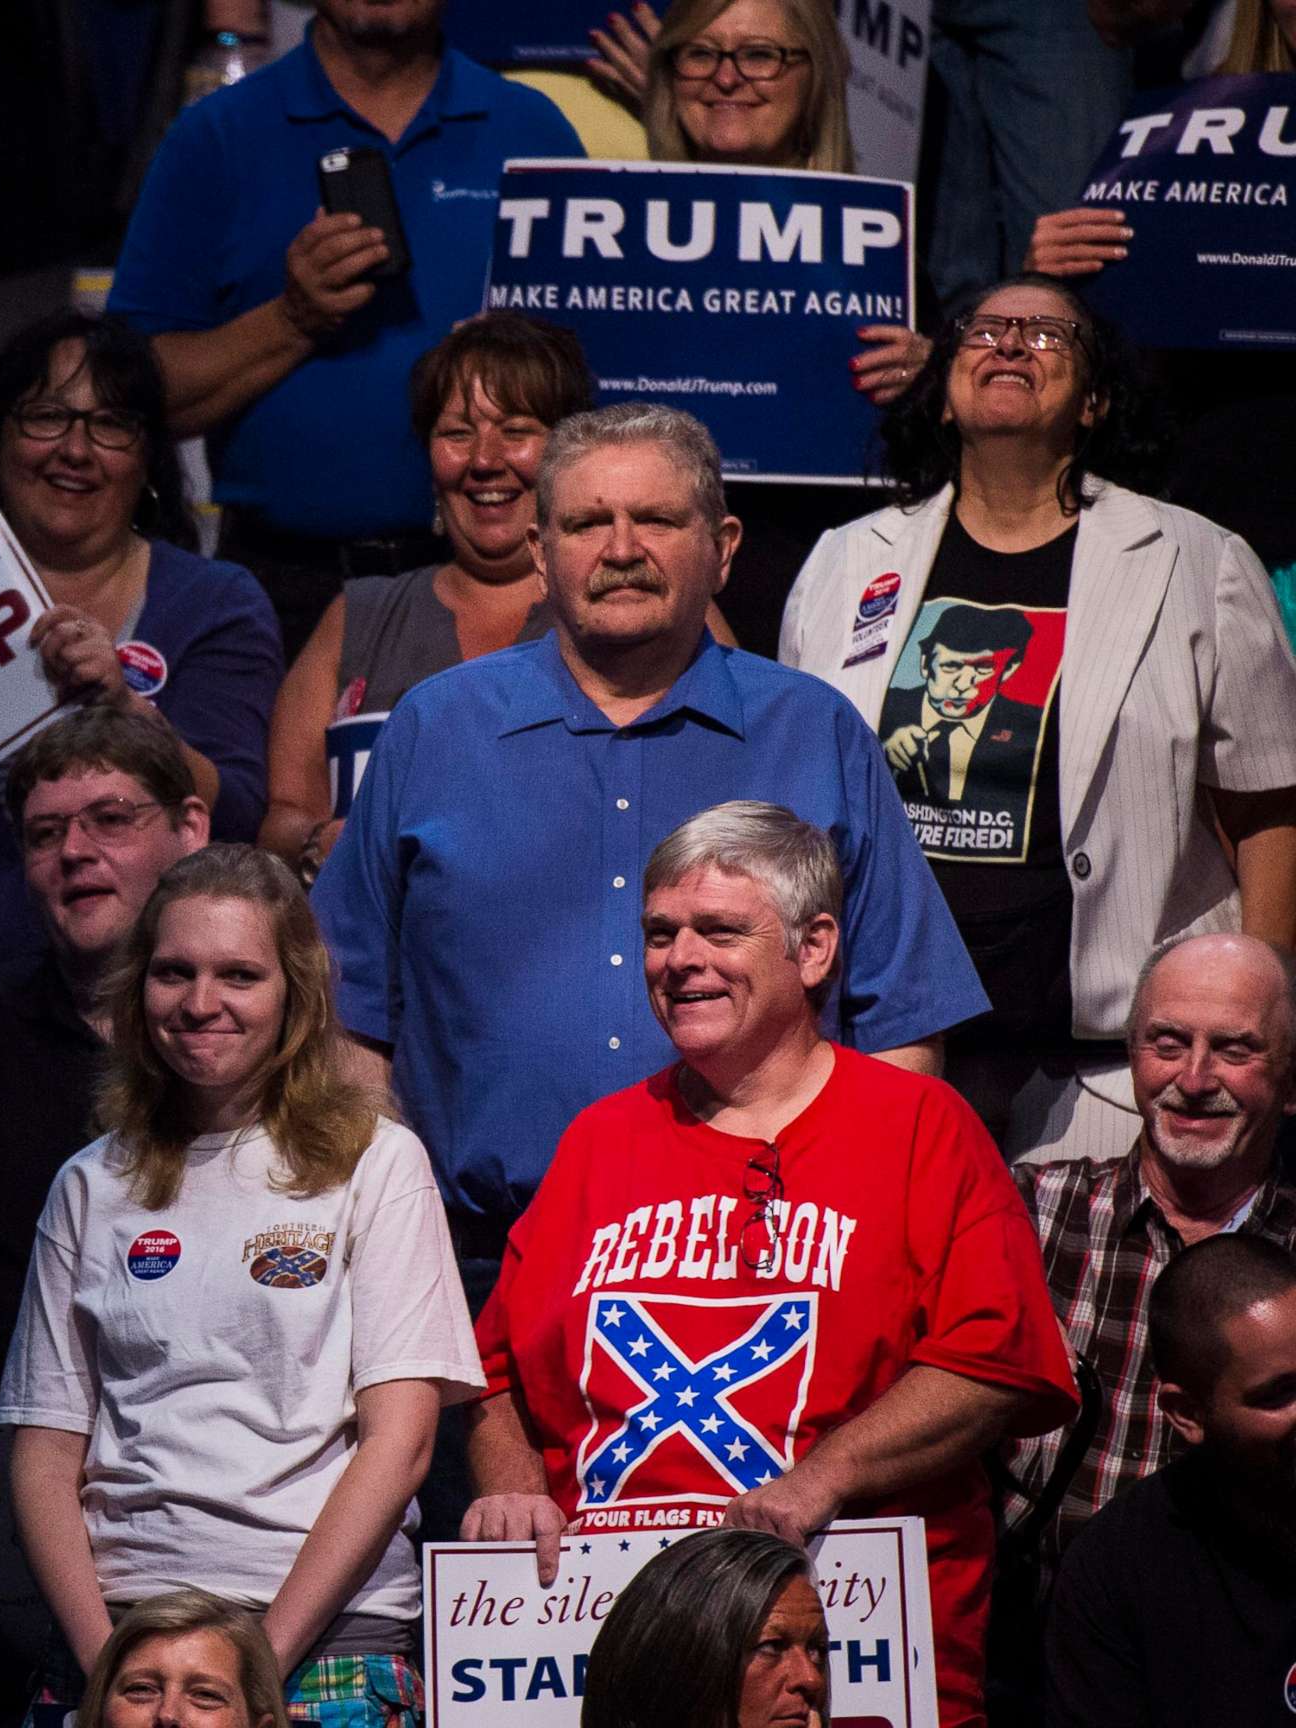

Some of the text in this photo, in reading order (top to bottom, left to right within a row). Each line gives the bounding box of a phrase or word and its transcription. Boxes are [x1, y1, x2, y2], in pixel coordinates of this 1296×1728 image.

[1119, 106, 1296, 158] TRU
[1083, 181, 1288, 206] MAKE AMERICA
[499, 198, 903, 266] TRUMP
[490, 285, 902, 319] MAKE AMERICA GREAT AGAIN!
[598, 376, 778, 397] www.DonaldJTrump.com
[979, 810, 1015, 827] D.C.
[944, 826, 1014, 849] FIRED!
[136, 1237, 178, 1247] TRUMP
[144, 1245, 166, 1254] 2016
[242, 1231, 336, 1262] HERITAGE
[572, 1194, 857, 1297] REBEL SON
[130, 1260, 173, 1270] AMERICA
[584, 1510, 630, 1528] YOUR
[634, 1509, 690, 1527] FLAGS
[696, 1509, 726, 1527] FLY
[450, 1579, 524, 1627] the
[537, 1575, 614, 1625] sile
